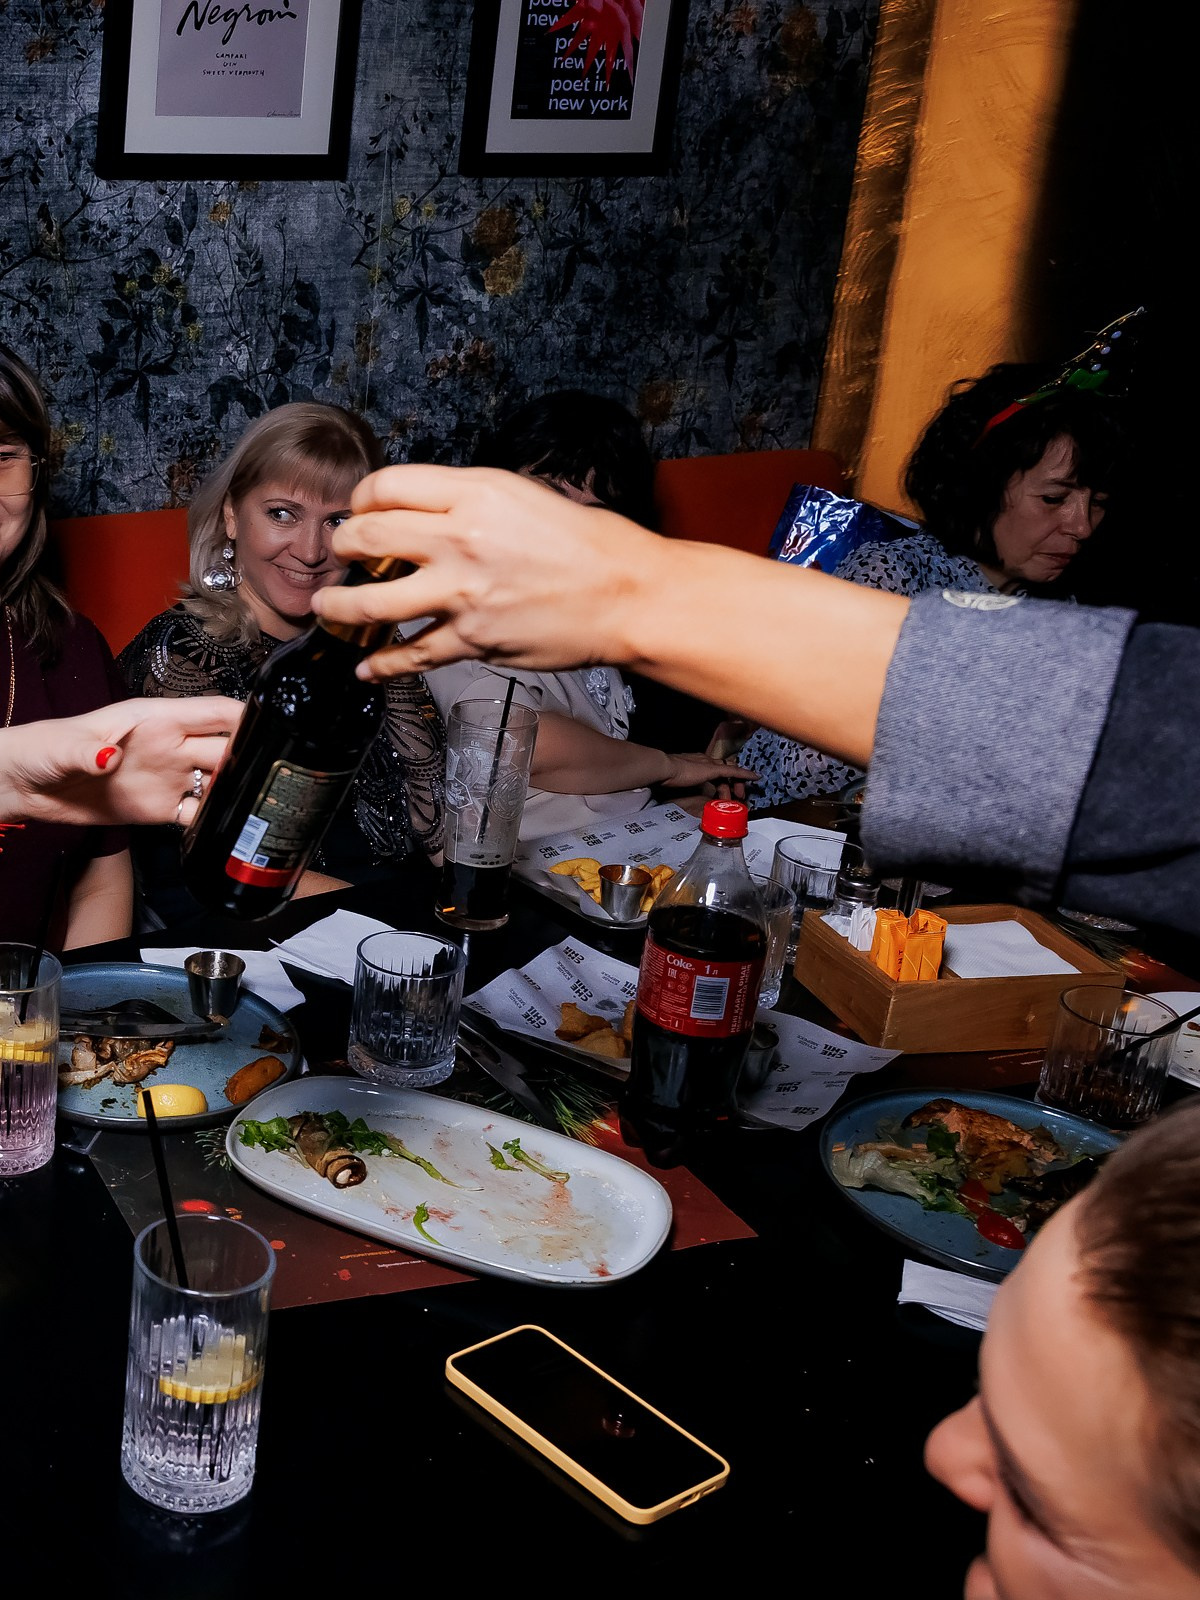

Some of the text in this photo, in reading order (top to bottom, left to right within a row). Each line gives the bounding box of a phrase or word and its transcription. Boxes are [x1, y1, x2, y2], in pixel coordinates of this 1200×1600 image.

[215, 52, 248, 60] CAMPARI
[229, 69, 265, 77] VERMOUTH
[550, 77, 591, 95] poet
[548, 95, 628, 115] new york
[666, 954, 692, 970] Coke
[704, 964, 711, 975] 1
